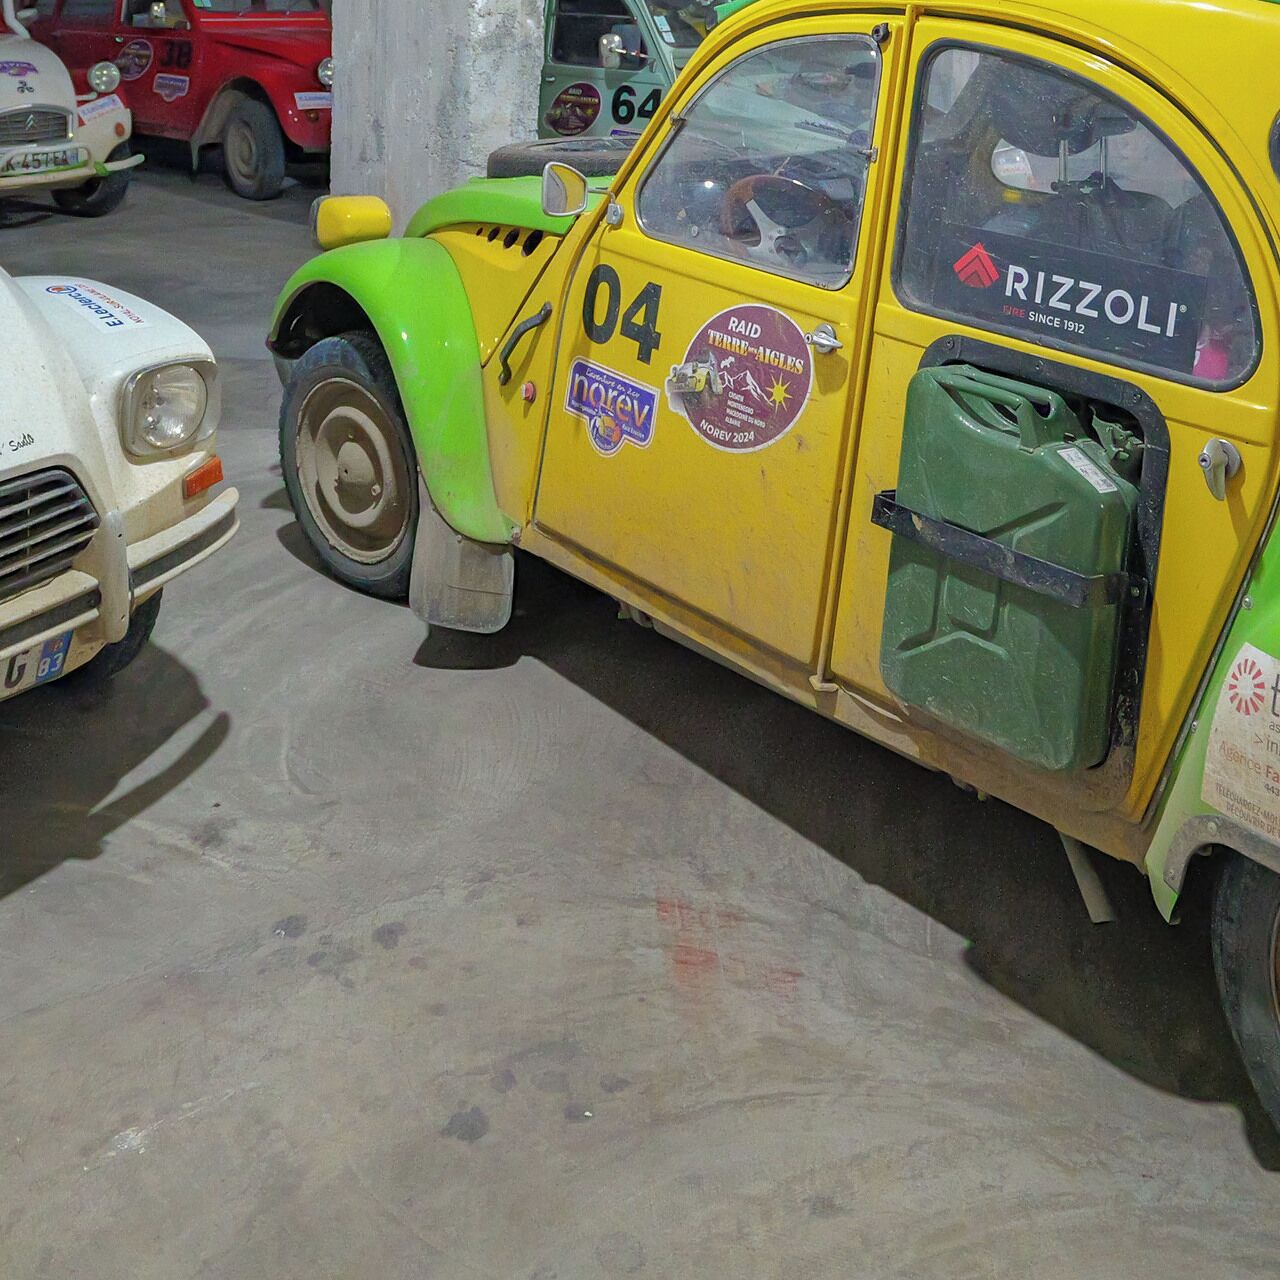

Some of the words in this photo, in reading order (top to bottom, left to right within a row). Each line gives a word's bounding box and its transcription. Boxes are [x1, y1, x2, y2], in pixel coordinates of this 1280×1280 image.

[612, 85, 662, 125] 64
[582, 264, 663, 365] 04
[728, 317, 762, 338] RAID
[1028, 311, 1061, 328] SINCE
[1063, 319, 1086, 335] 1912
[707, 329, 749, 356] TERRE
[755, 346, 804, 375] AIGLES
[573, 373, 650, 428] norev
[700, 419, 732, 441] NOREV
[732, 431, 755, 443] 2024
[38, 652, 64, 677] 83
[1220, 740, 1262, 776] Agence
